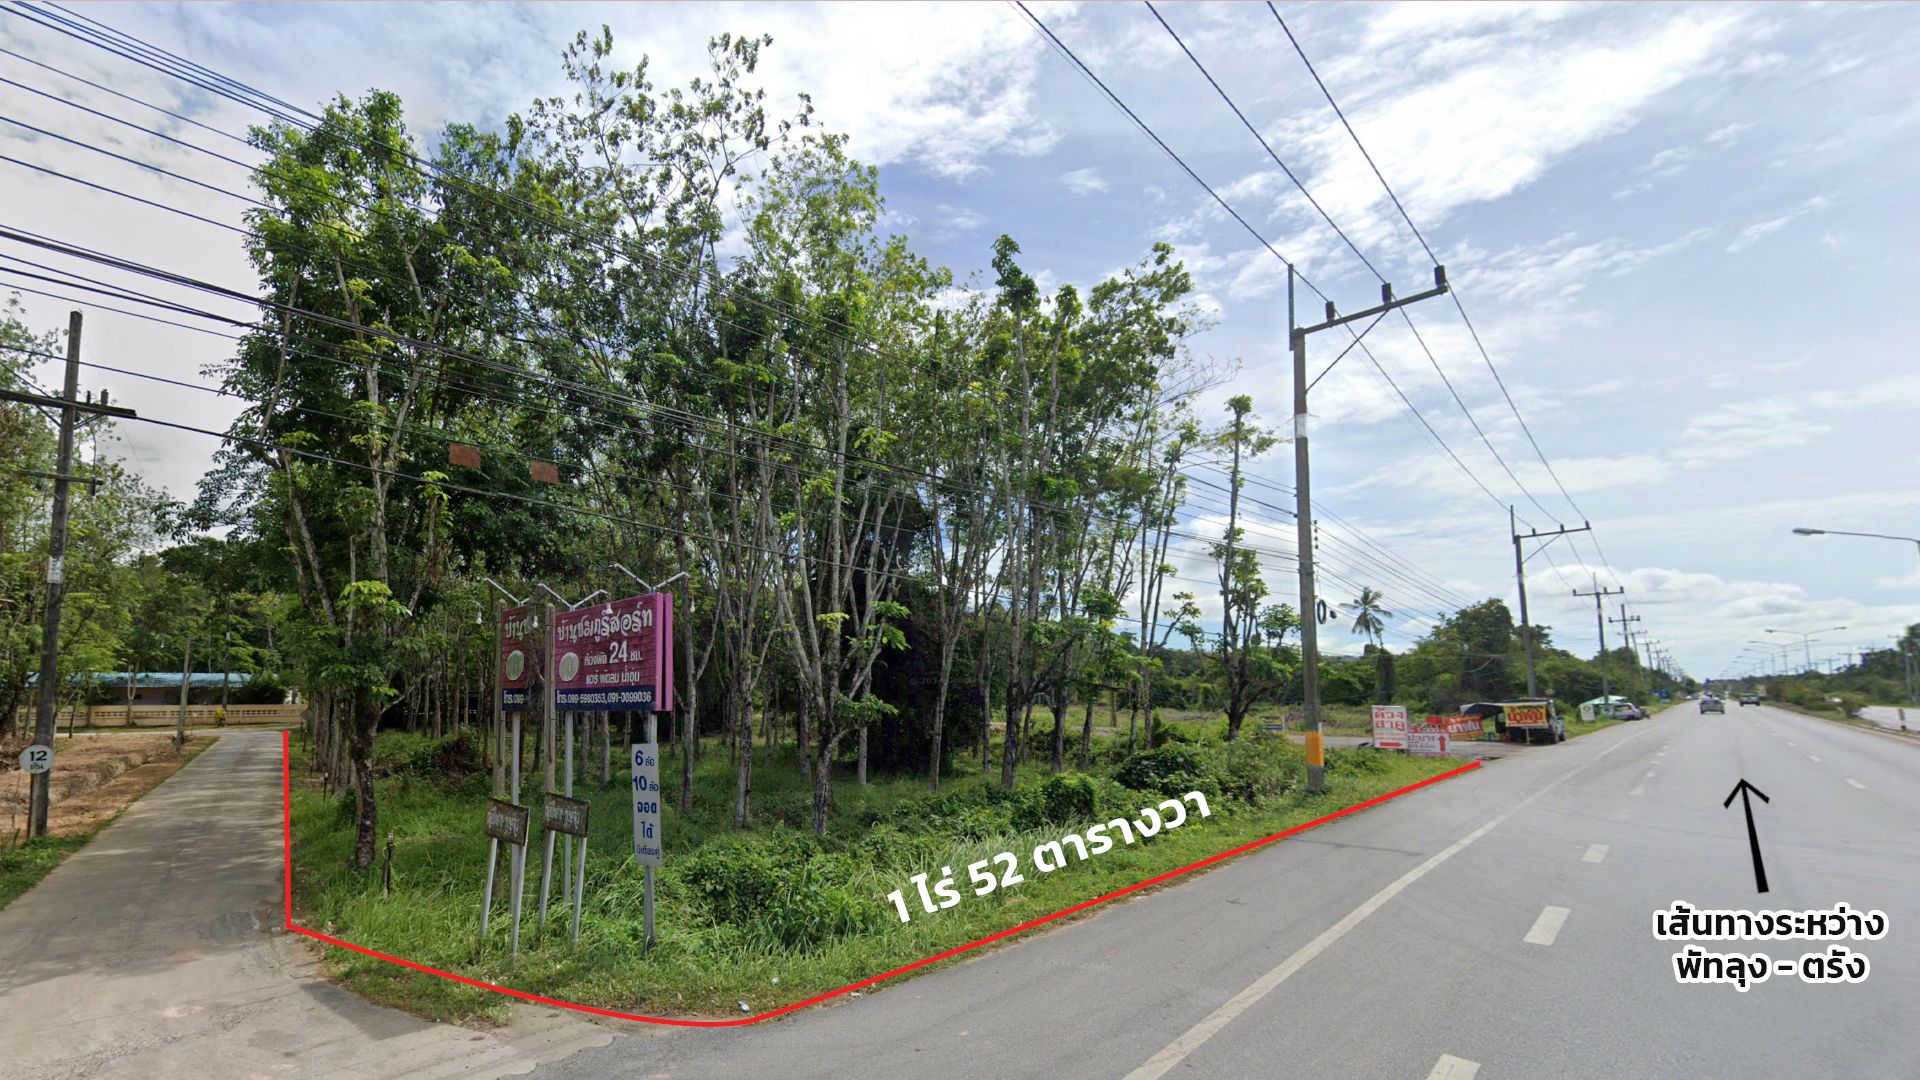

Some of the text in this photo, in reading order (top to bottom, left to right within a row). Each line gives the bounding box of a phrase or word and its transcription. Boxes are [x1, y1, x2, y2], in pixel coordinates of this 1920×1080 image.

[609, 640, 628, 664] 24
[30, 750, 48, 761] 12
[635, 750, 644, 766] 6
[632, 775, 647, 791] 10
[637, 801, 657, 814] จอด
[640, 821, 655, 839] ได้
